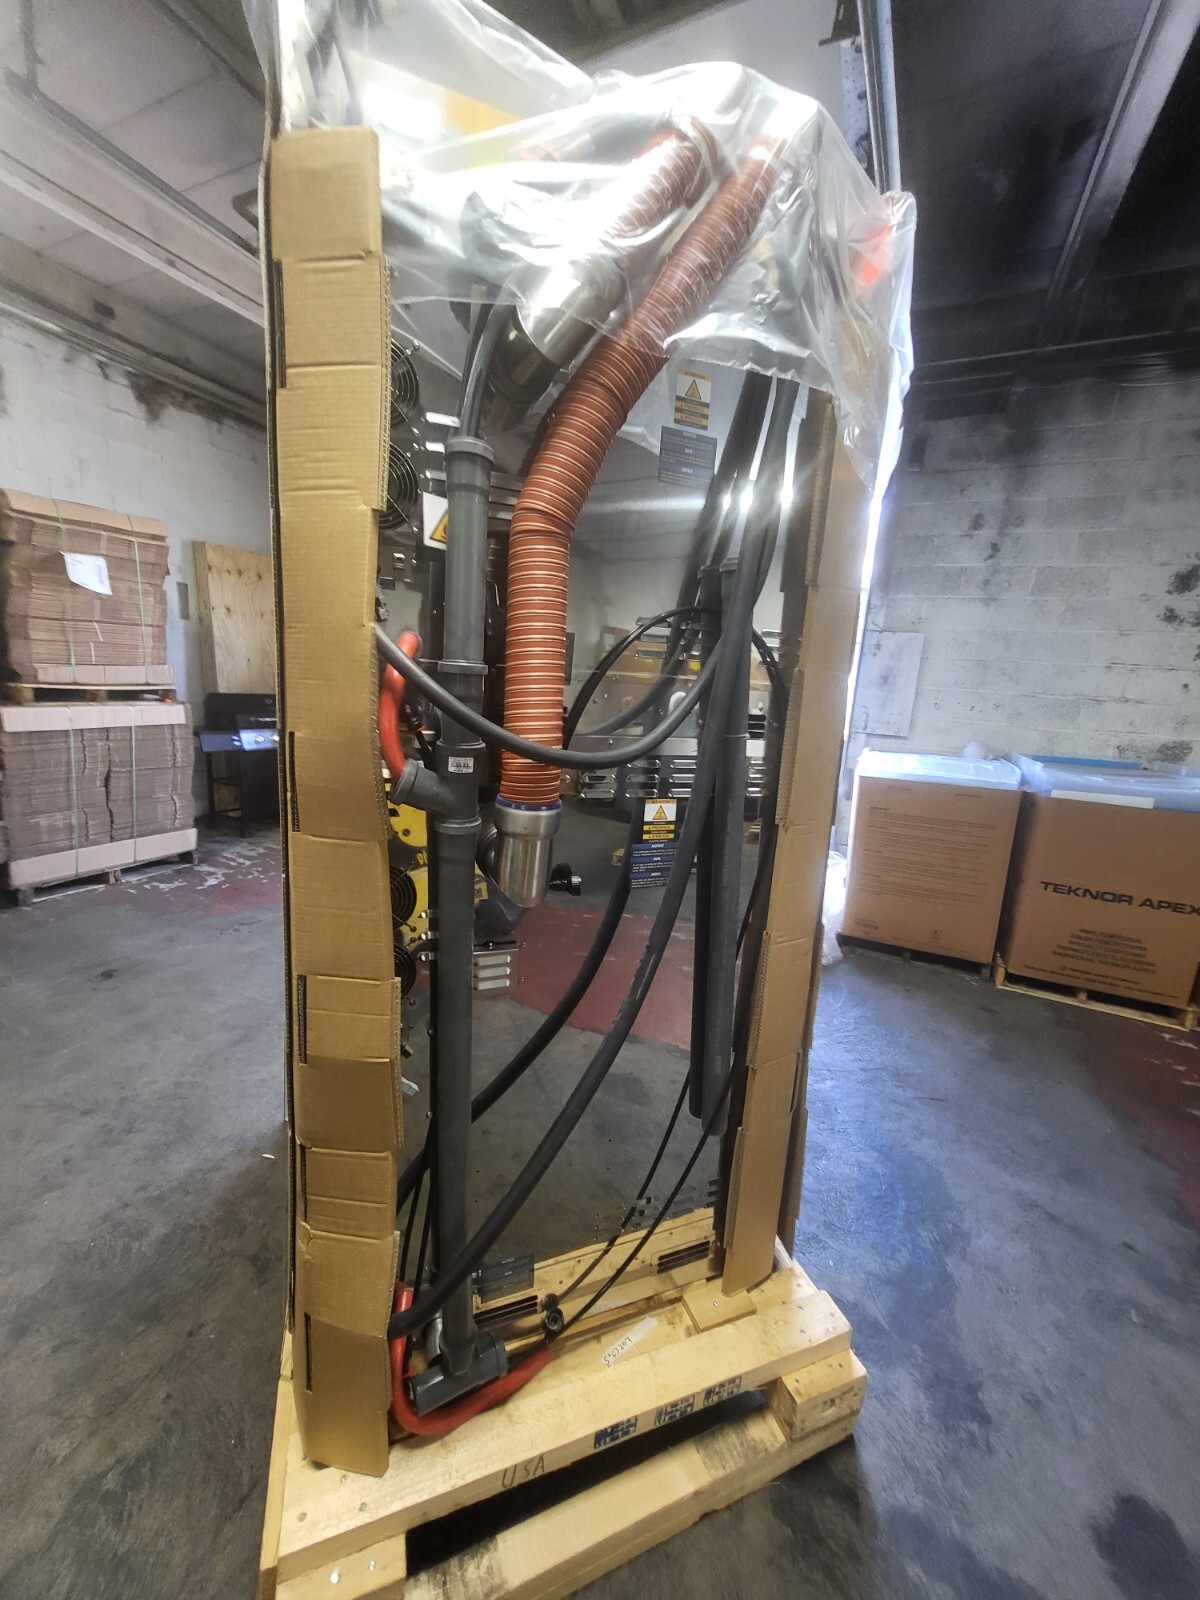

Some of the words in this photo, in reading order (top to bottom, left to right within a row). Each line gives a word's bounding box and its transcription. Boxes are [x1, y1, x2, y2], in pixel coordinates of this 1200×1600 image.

[1040, 881, 1134, 906] TEKNOR
[1139, 898, 1200, 916] APEX
[501, 1455, 545, 1489] USA
